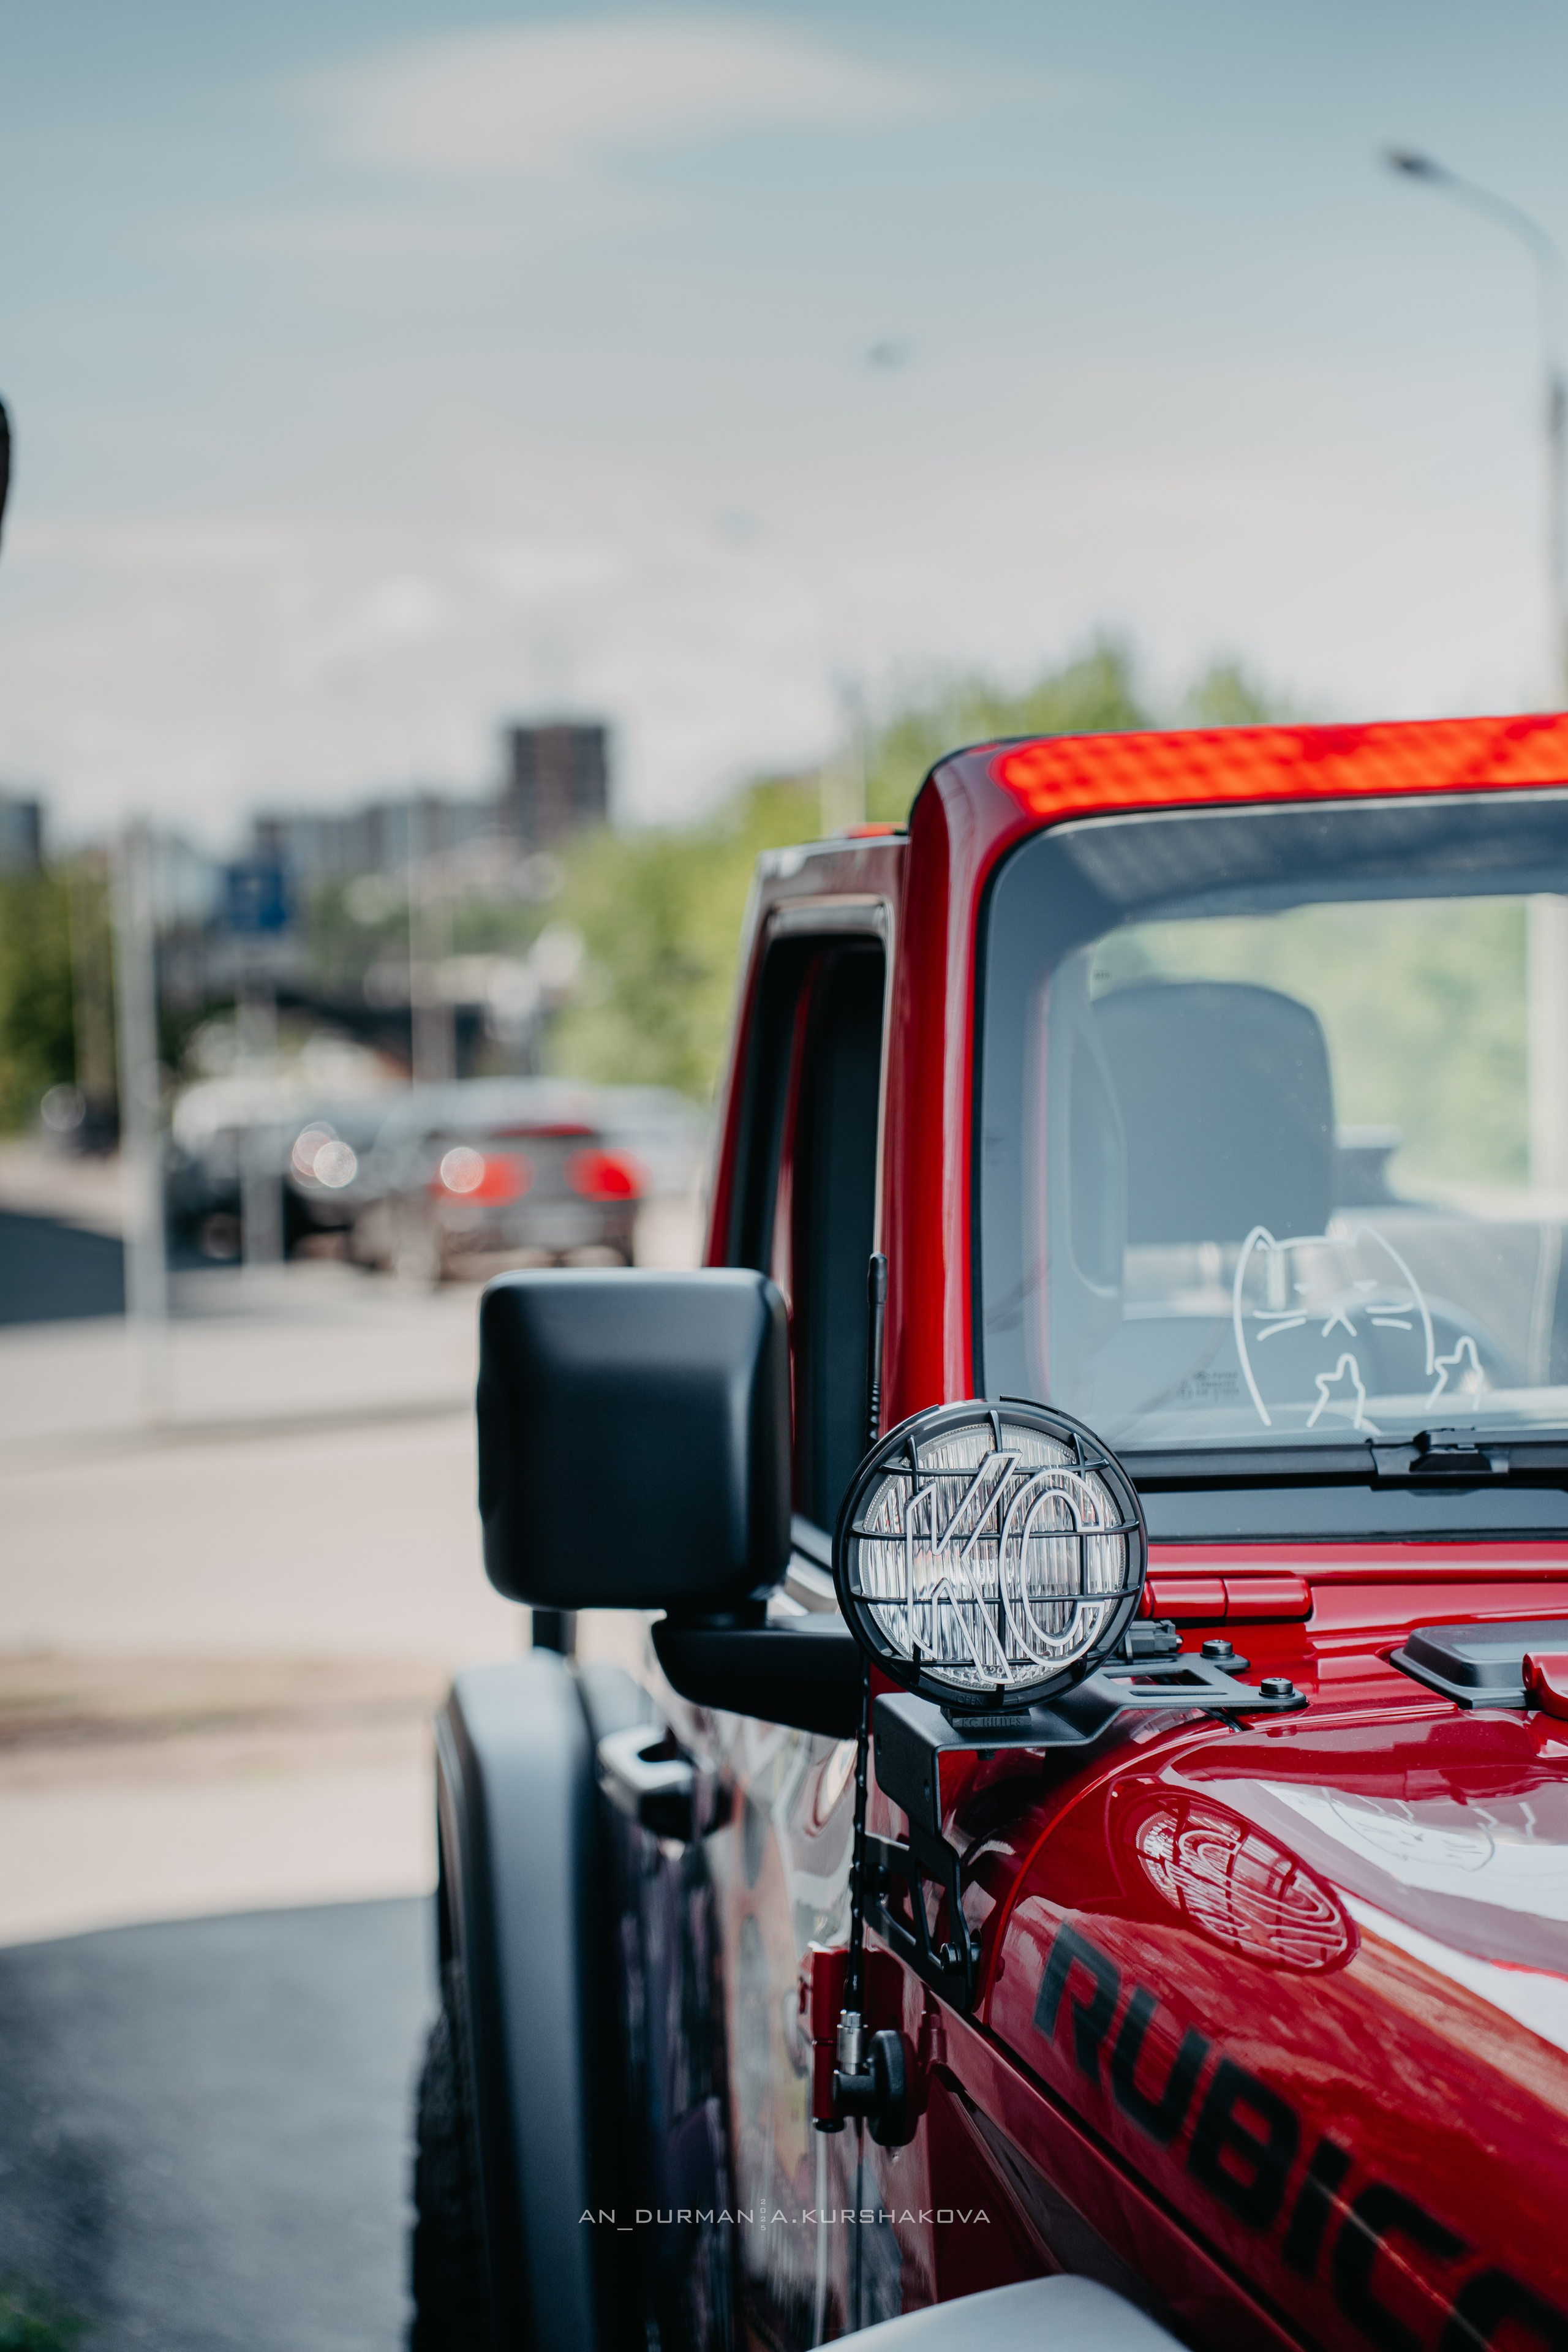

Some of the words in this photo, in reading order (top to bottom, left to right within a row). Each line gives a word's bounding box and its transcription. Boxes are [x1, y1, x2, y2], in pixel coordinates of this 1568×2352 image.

[907, 1450, 1105, 1684] KC
[957, 1695, 982, 1705] OPEN
[962, 1719, 978, 1728] KC
[983, 1717, 1021, 1727] HILITES
